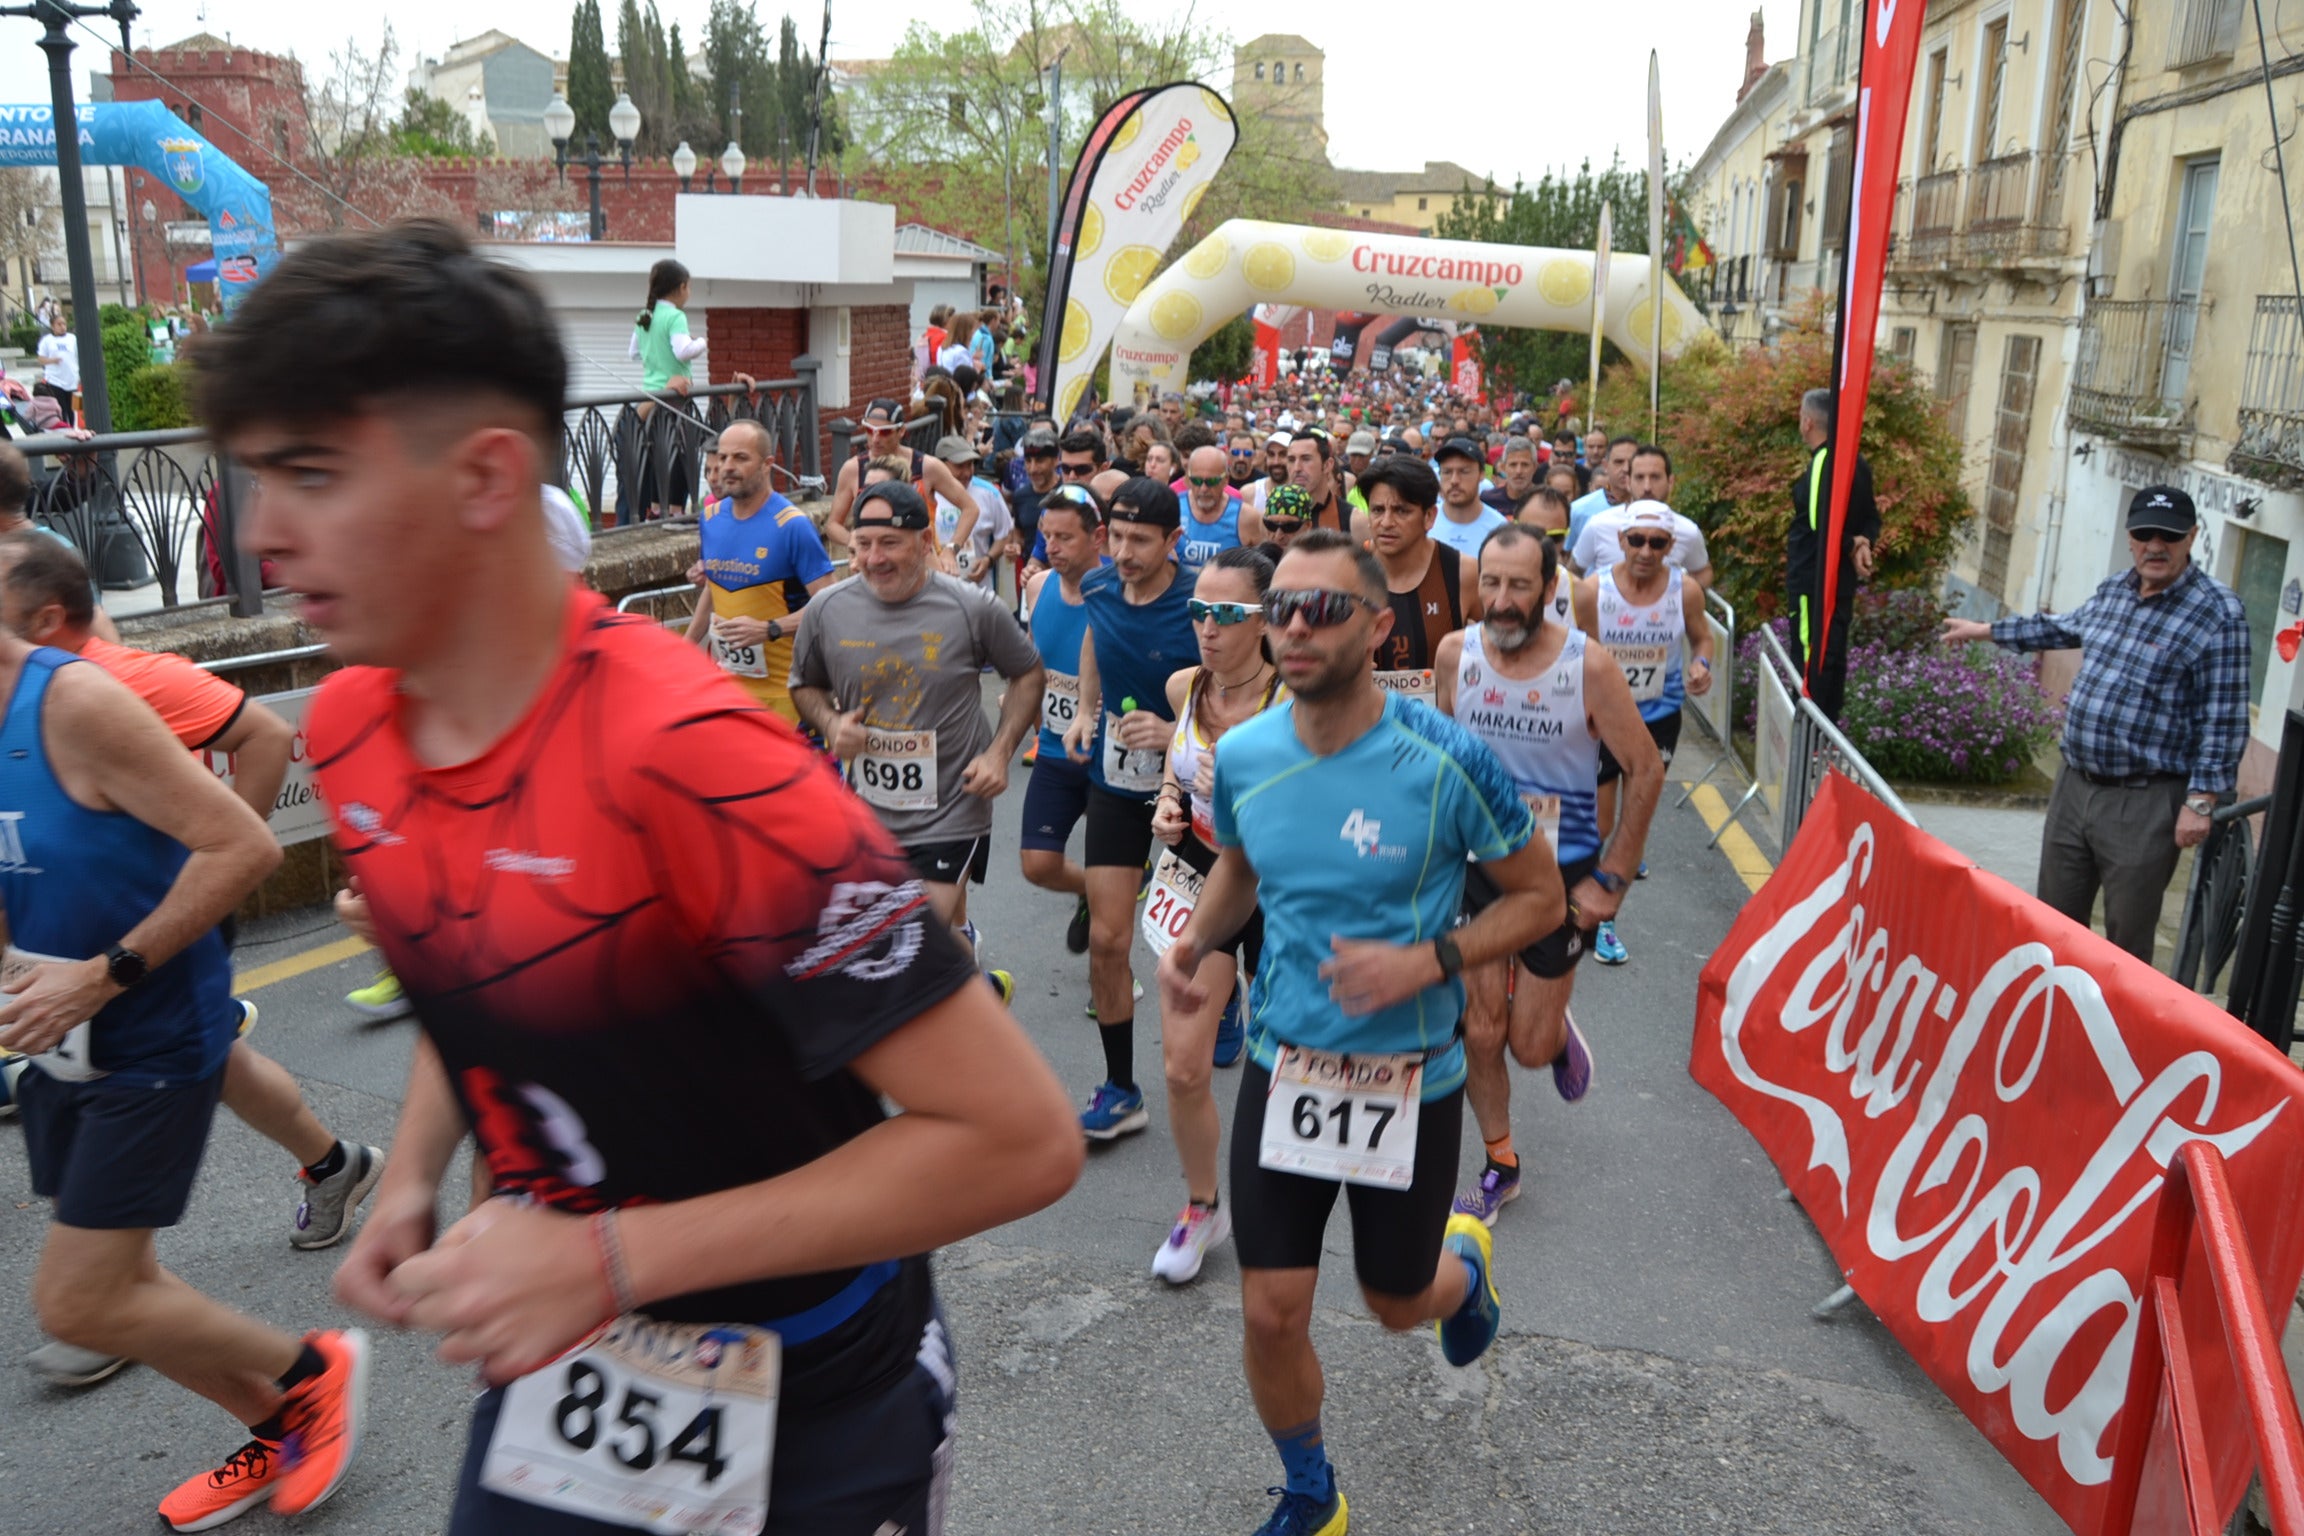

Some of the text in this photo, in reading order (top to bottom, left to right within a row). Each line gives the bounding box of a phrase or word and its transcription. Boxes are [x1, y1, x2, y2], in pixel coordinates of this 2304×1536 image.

[0, 128, 95, 146] RANAA
[1115, 117, 1193, 212] Cruzcampo
[1140, 170, 1182, 215] Radler
[1352, 244, 1523, 288] Cruzcampo
[1366, 281, 1447, 310] Radler
[1116, 344, 1179, 365] Cruzcampo
[1605, 629, 1674, 643] MARACENA
[1047, 692, 1079, 720] 26
[1469, 708, 1563, 737] MARACENA
[863, 758, 923, 791] 698
[268, 781, 324, 813] dler
[1148, 886, 1193, 938] 210
[1292, 1094, 1397, 1151] 617
[1720, 822, 2291, 1486] Coca-Cola
[553, 1359, 730, 1486] 854
